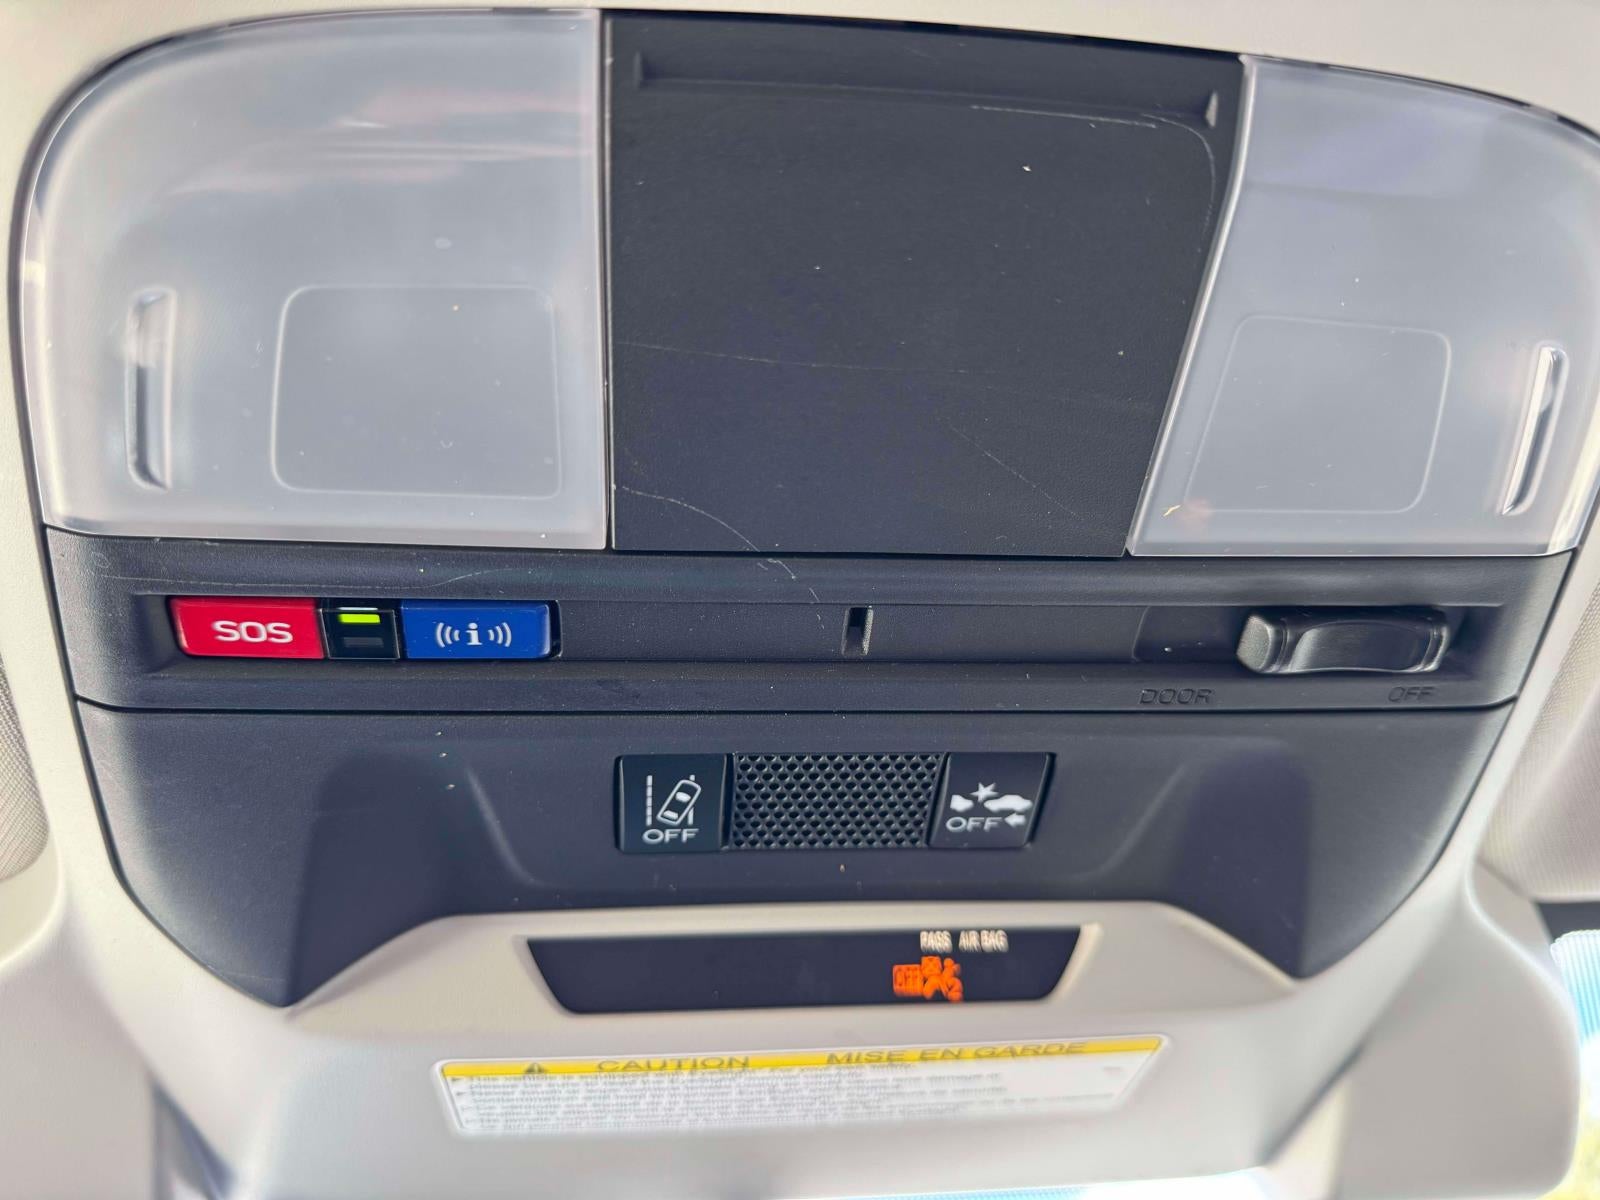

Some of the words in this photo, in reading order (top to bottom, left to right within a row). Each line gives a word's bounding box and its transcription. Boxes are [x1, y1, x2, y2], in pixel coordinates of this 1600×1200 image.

[211, 619, 294, 644] SOS
[1138, 687, 1213, 705] DOOR
[1387, 685, 1438, 703] OFF
[945, 815, 1003, 833] OFF
[641, 827, 699, 845] OFF
[919, 930, 953, 953] PASS
[958, 930, 981, 952] AIR
[980, 929, 1009, 953] BAG
[596, 1055, 751, 1074] CAUTION
[825, 1049, 905, 1065] MISE
[918, 1047, 964, 1061] EN
[973, 1041, 1088, 1059] GARDE
